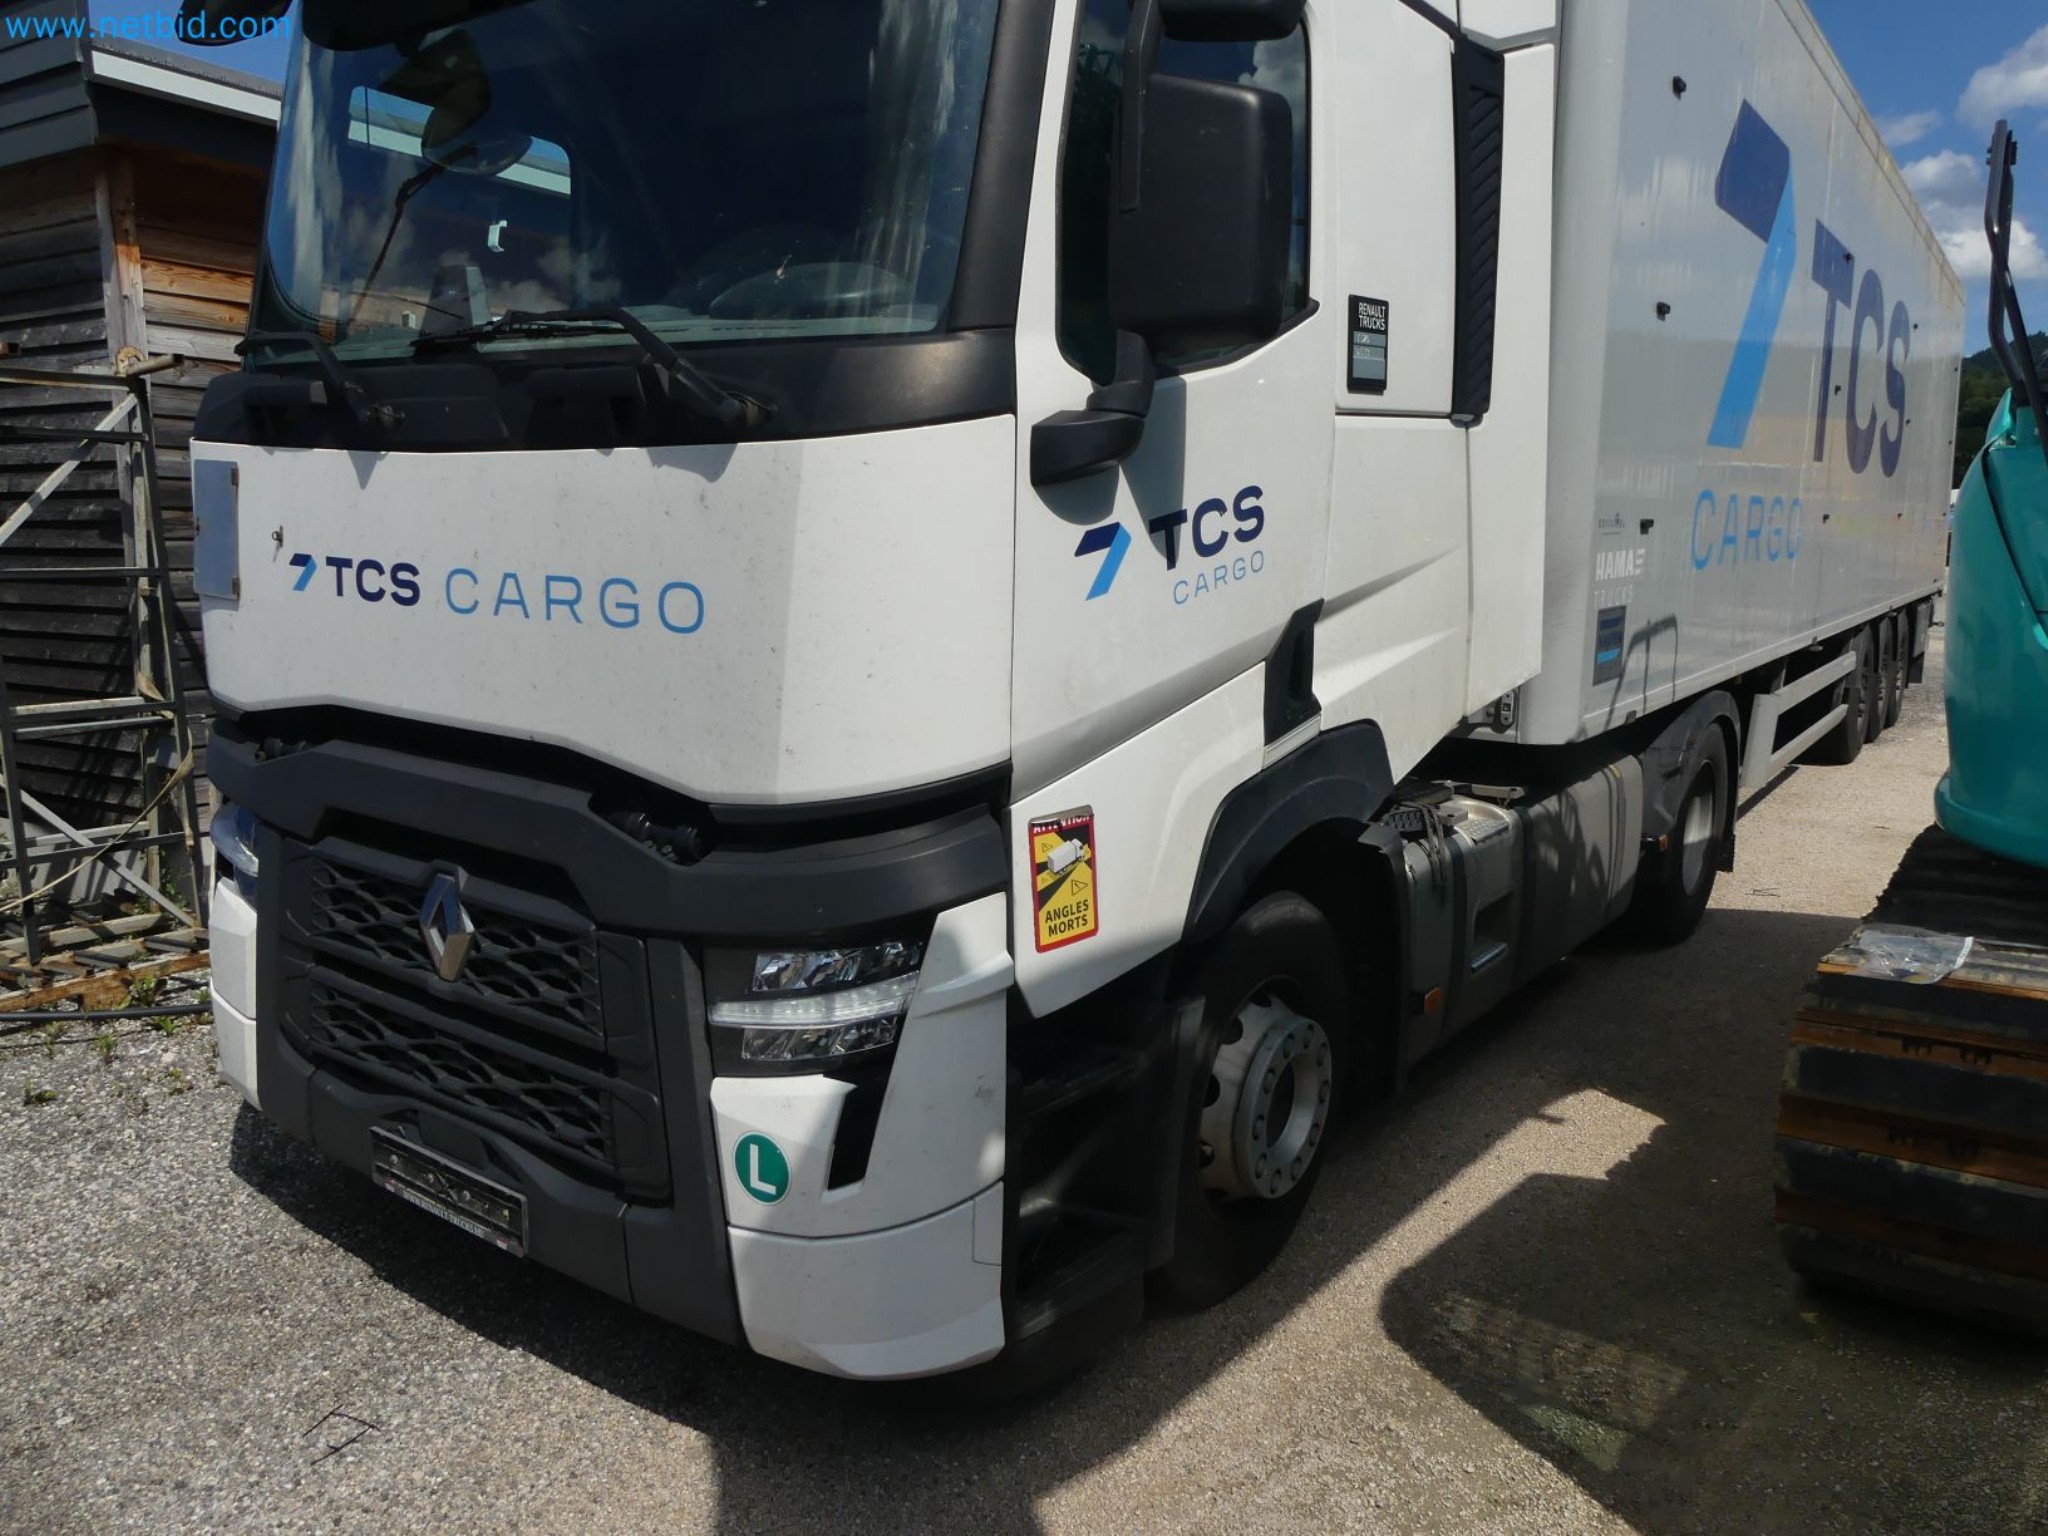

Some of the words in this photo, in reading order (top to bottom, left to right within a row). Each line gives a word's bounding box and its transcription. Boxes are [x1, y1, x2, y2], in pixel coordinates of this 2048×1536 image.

[1358, 301, 1386, 318] RENAULT
[1358, 314, 1386, 331] TRUCKS
[1812, 218, 1910, 478] TCS
[1148, 485, 1265, 571] TCS
[1690, 489, 1803, 571] CARGO
[325, 555, 421, 606] TCS
[445, 568, 705, 634] CARGO
[1173, 550, 1265, 605] CARGO
[1045, 899, 1089, 924] ANGLES
[1048, 914, 1088, 937] MORTS
[749, 1143, 776, 1196] L
